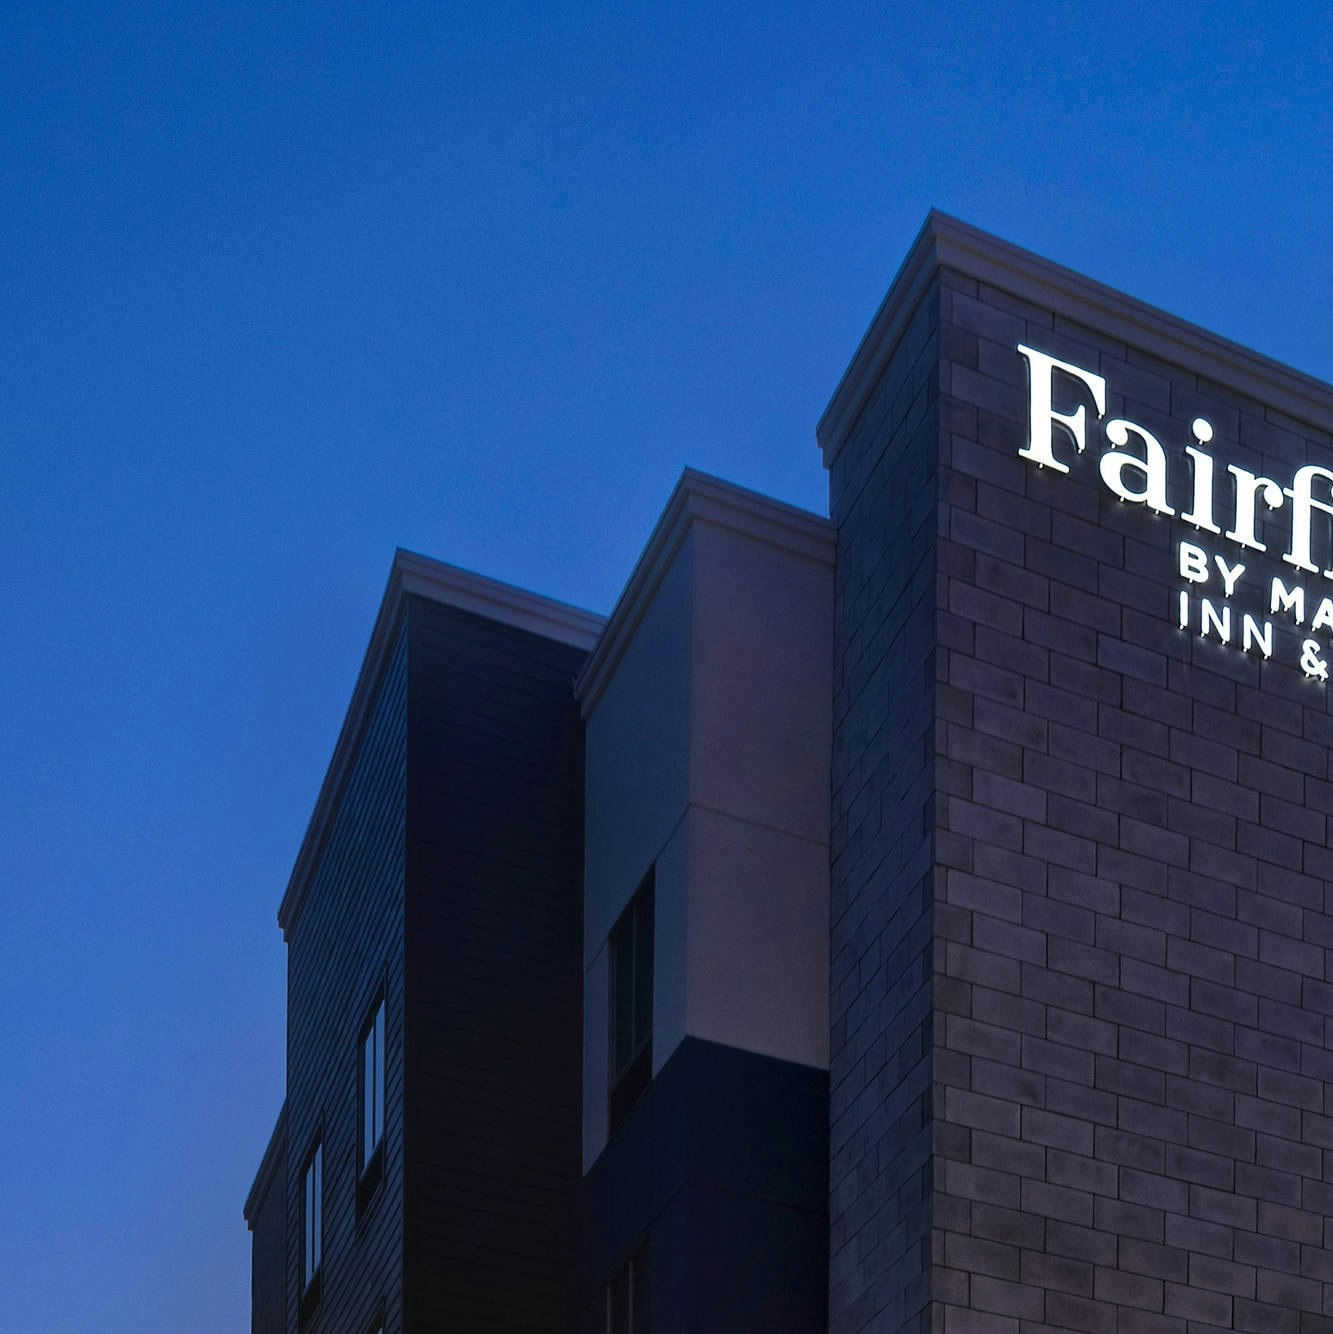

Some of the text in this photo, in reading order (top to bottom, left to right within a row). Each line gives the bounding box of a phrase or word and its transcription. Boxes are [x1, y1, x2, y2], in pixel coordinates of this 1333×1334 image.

[1178, 540, 1247, 599] BY
[1178, 590, 1274, 661] INN
[1299, 638, 1330, 683] &
